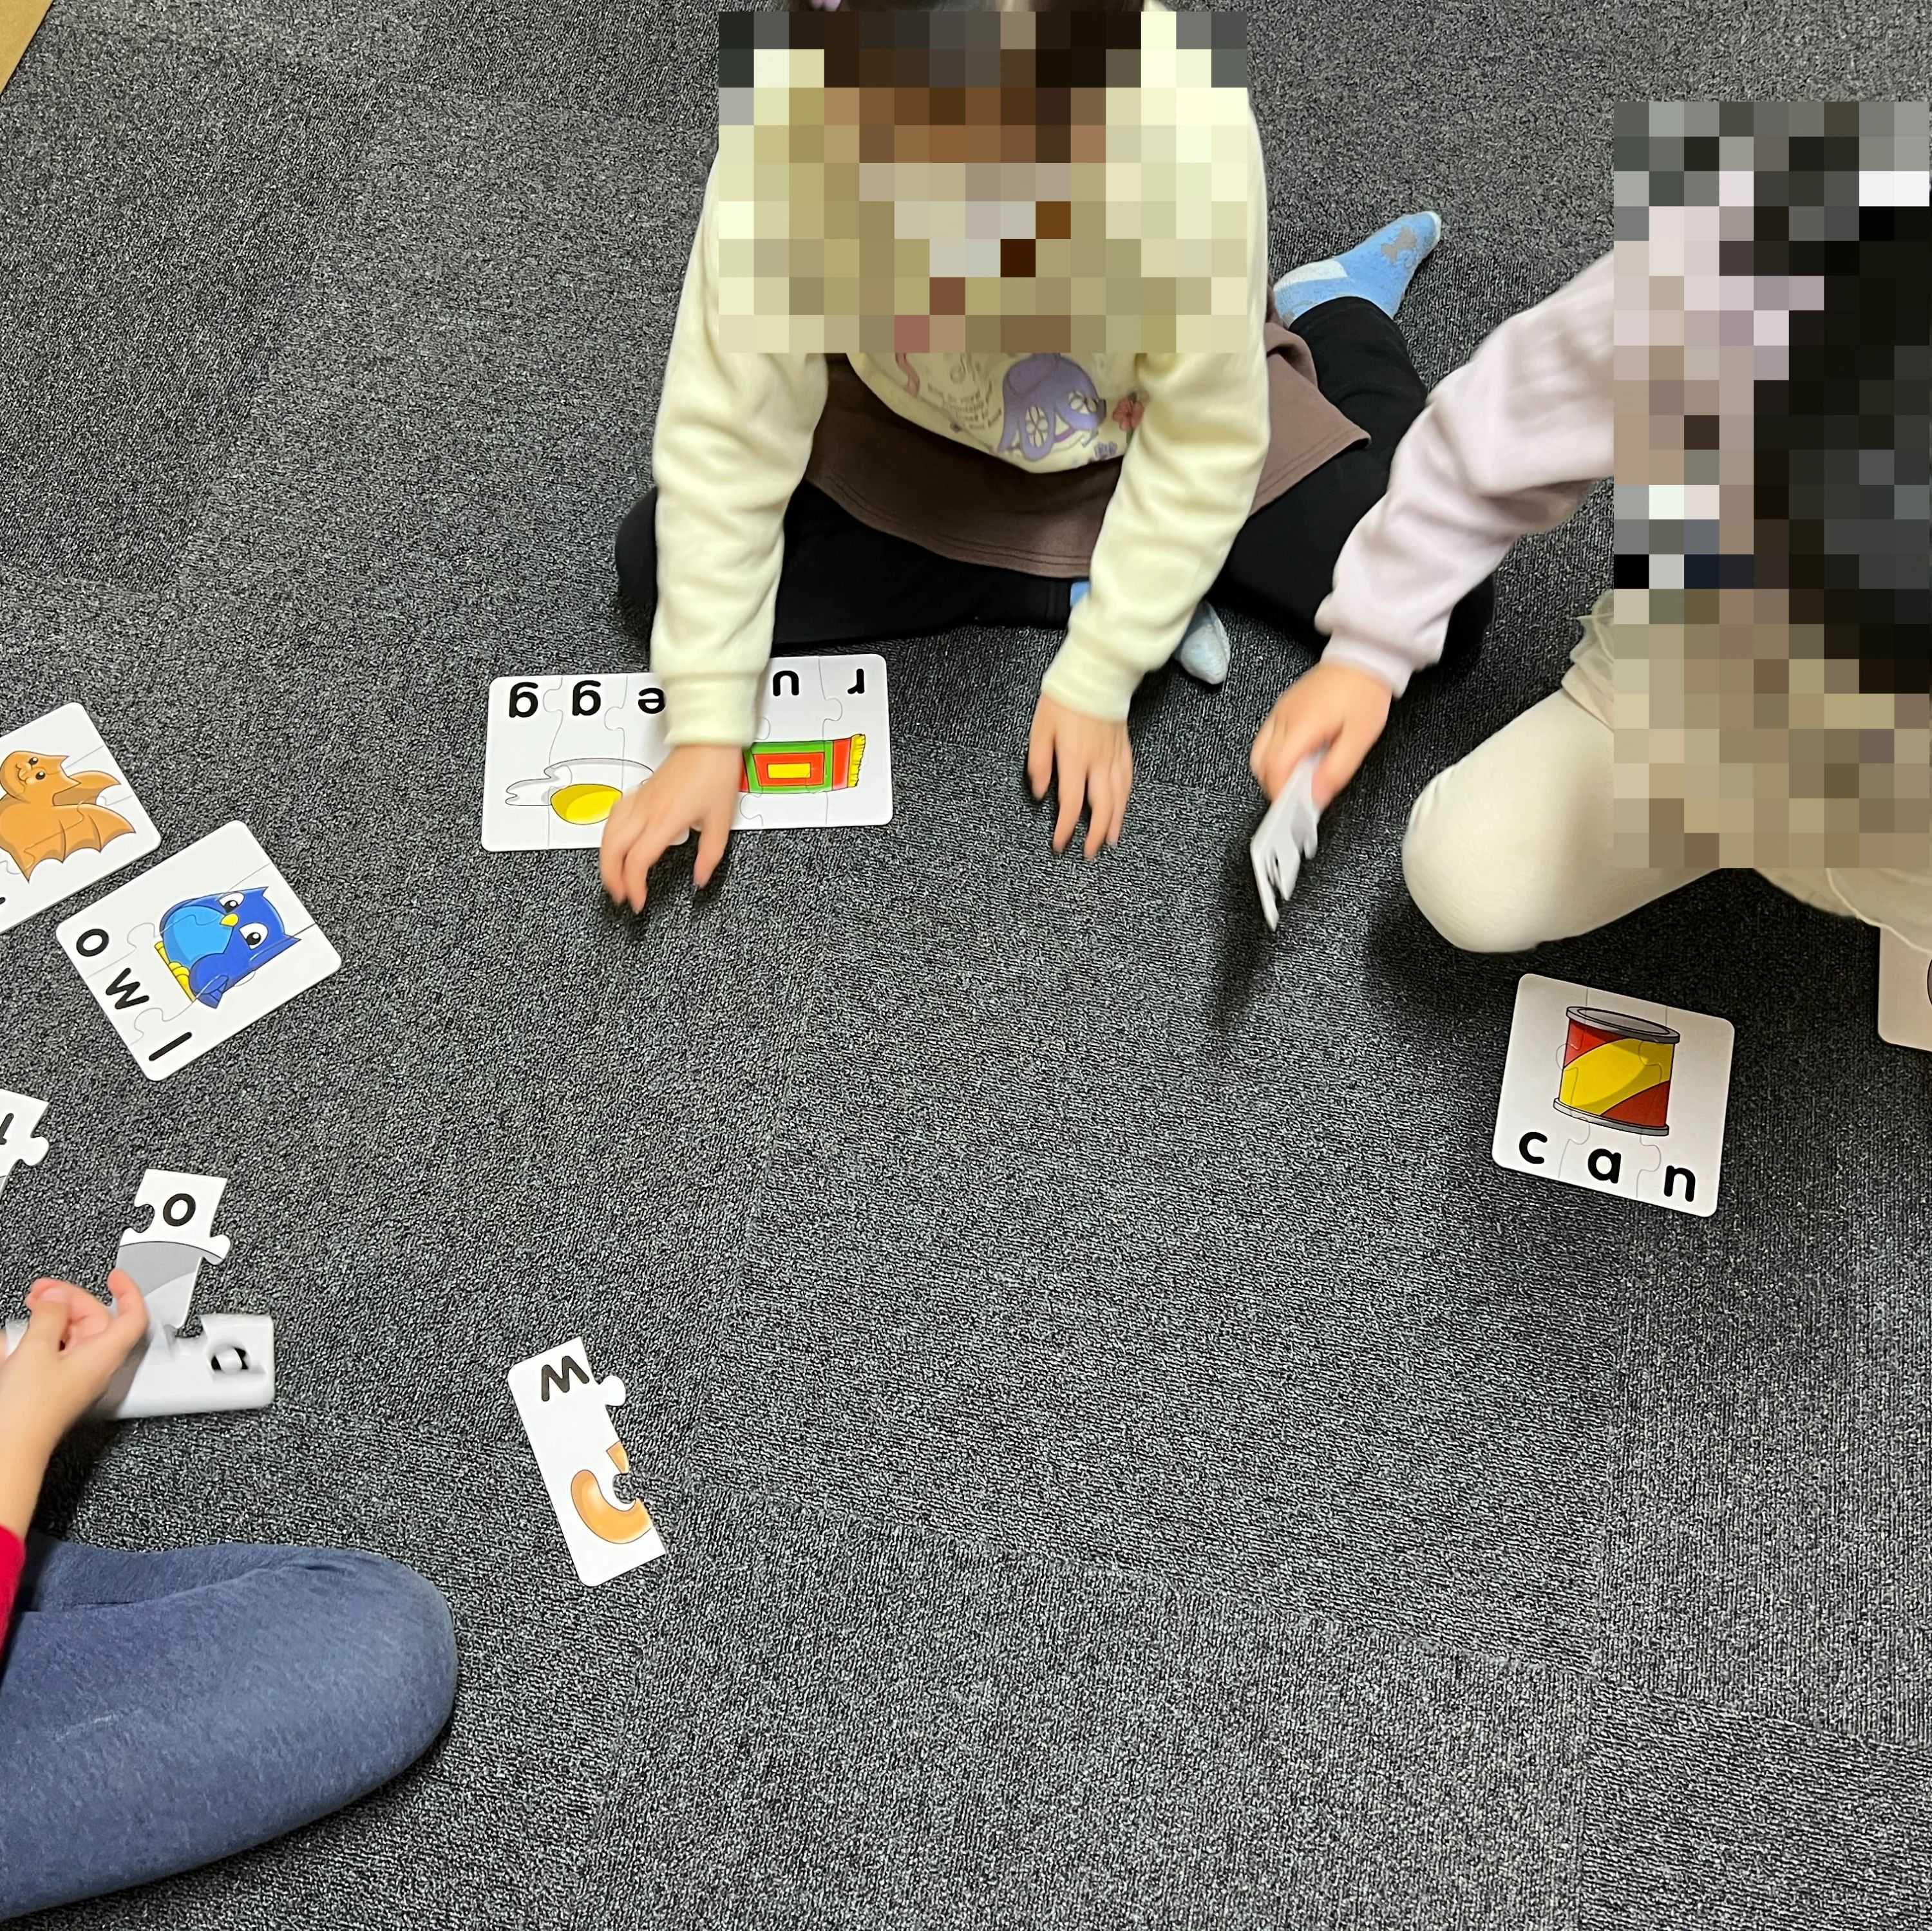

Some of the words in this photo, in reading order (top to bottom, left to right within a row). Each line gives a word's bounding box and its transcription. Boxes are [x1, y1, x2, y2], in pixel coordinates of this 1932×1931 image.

[508, 680, 666, 718] egg
[772, 668, 865, 697] ru
[76, 928, 193, 1062] owl
[1518, 1131, 1696, 1202] can
